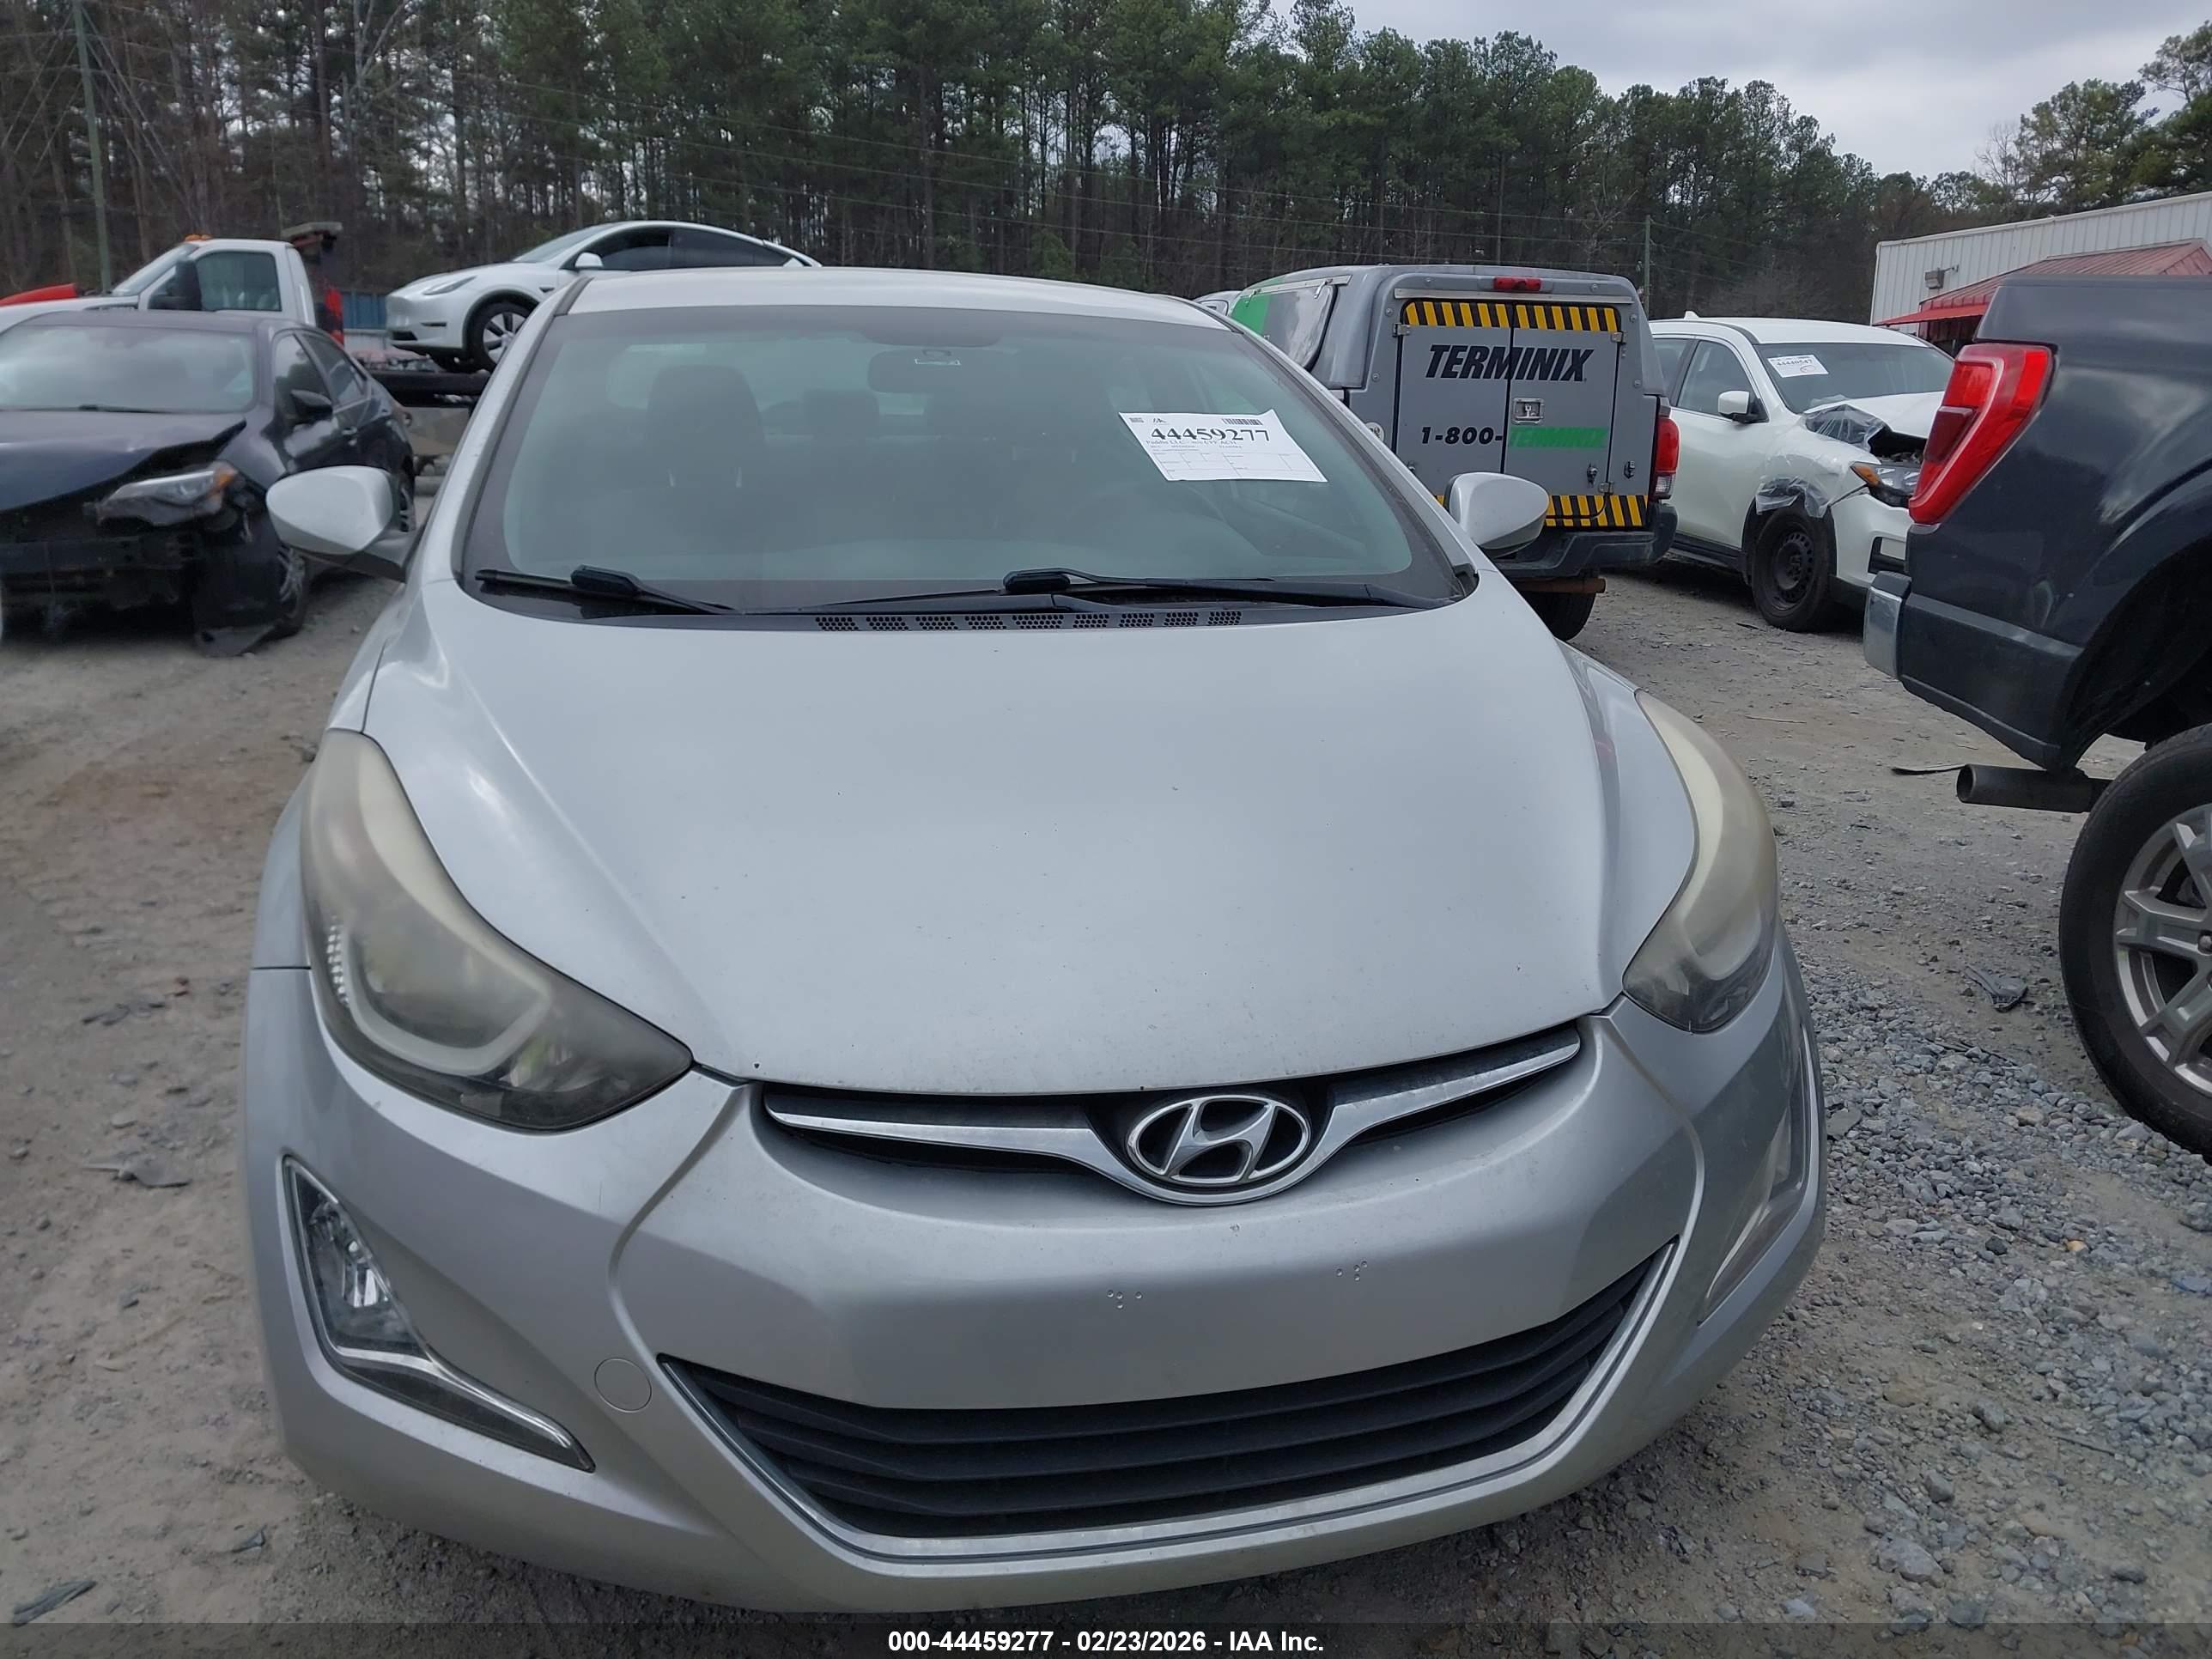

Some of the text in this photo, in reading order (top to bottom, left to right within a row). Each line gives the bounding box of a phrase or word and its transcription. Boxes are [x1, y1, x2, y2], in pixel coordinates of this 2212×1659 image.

[1425, 344, 1595, 382] TERMINIX
[1151, 428, 1270, 441] 44459277
[1421, 426, 1504, 445] 1-800-
